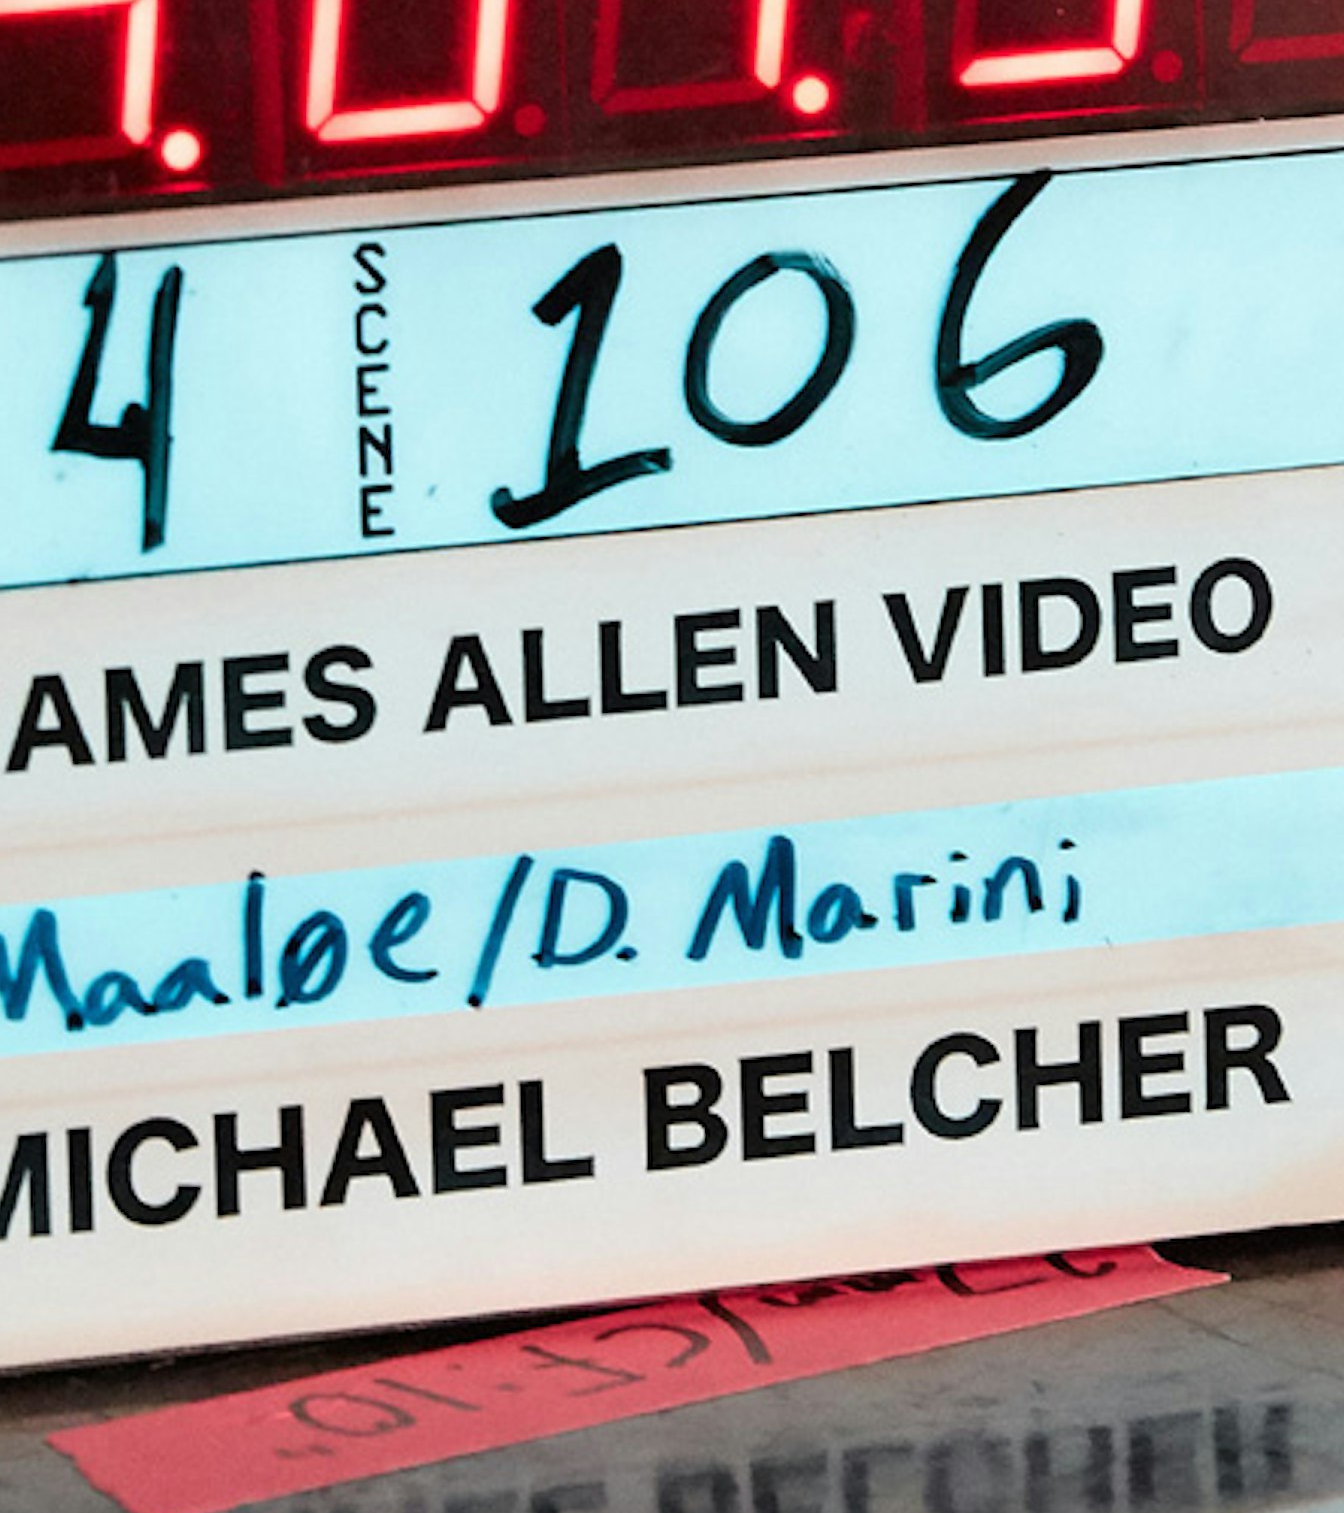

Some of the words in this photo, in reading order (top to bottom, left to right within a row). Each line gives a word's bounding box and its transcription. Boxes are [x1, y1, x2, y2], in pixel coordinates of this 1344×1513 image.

[353, 242, 395, 538] SCENE
[491, 168, 1103, 528] 106
[423, 599, 838, 733] ALLEN
[882, 557, 1274, 684] VIDEO
[686, 835, 1082, 962] Marini
[643, 1004, 1292, 1172] BELCHER
